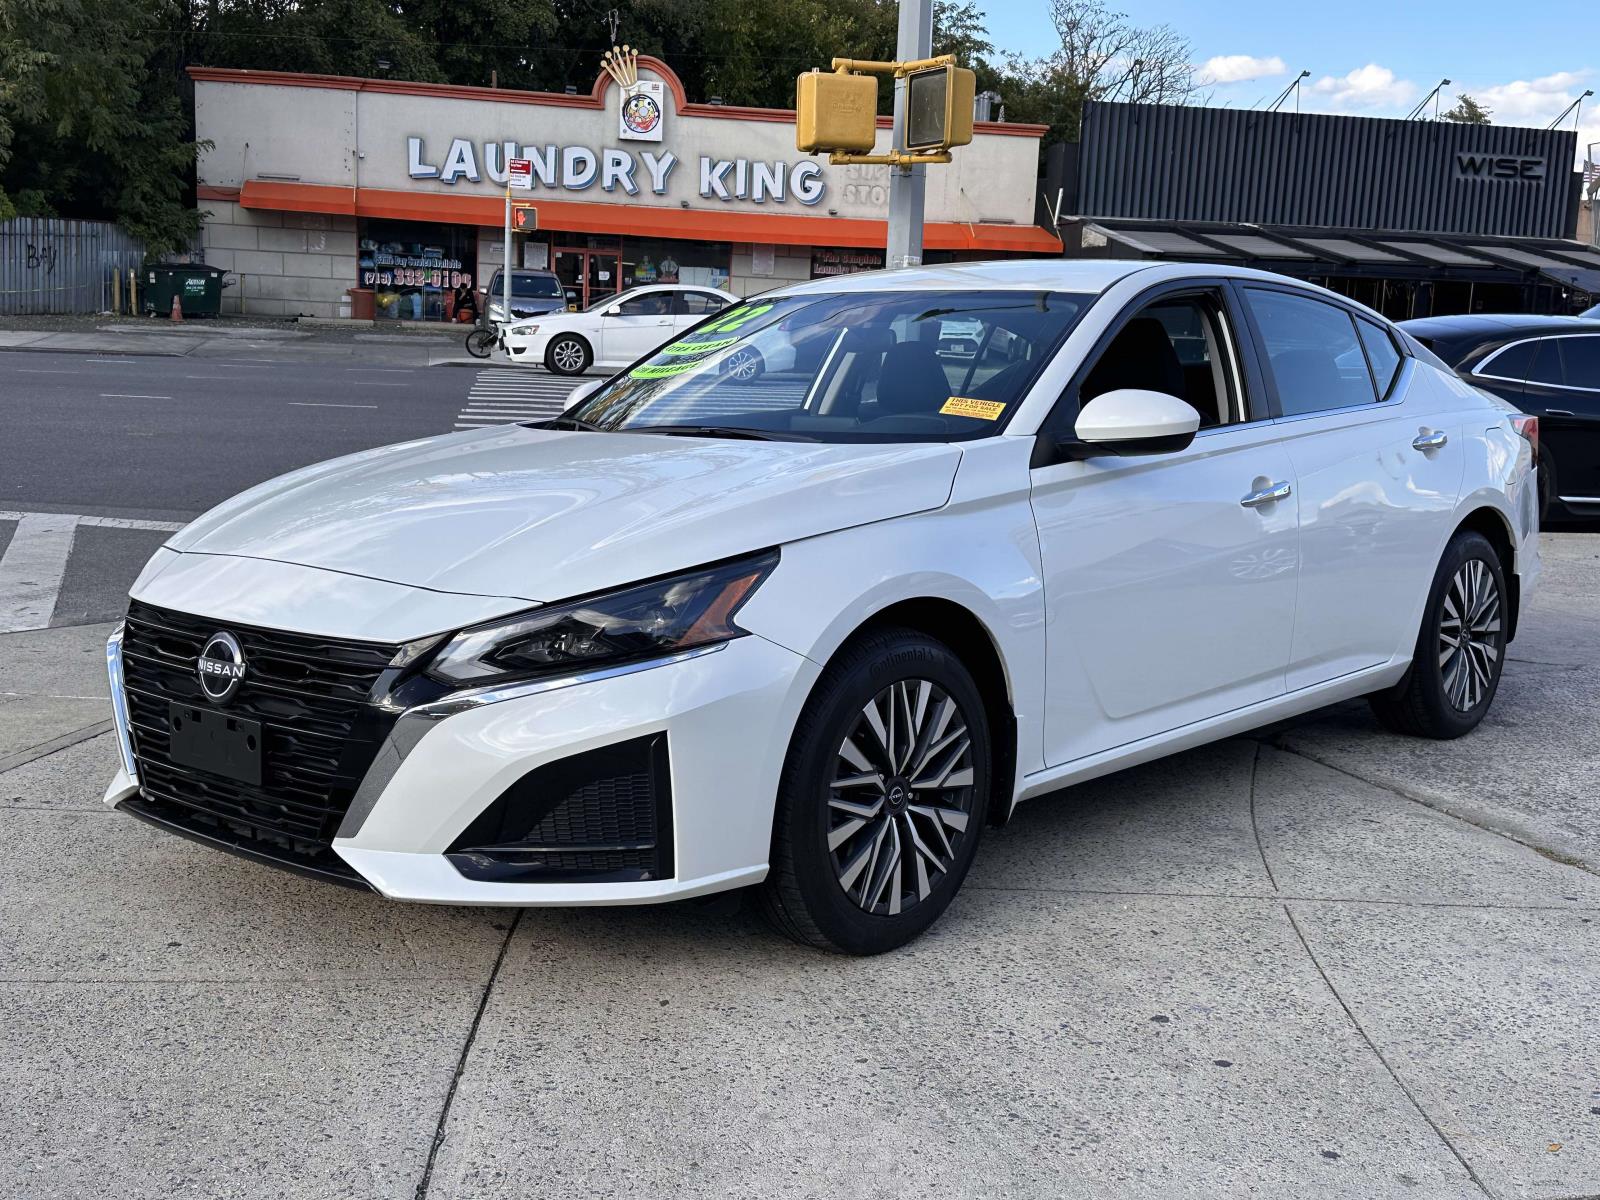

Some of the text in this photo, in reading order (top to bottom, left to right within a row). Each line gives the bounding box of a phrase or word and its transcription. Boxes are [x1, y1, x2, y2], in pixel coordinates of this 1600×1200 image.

[407, 137, 826, 207] LAUNDRY KING
[1456, 154, 1543, 181] WISE
[970, 399, 1001, 408] VEHICLE
[198, 658, 244, 678] NISSAN
